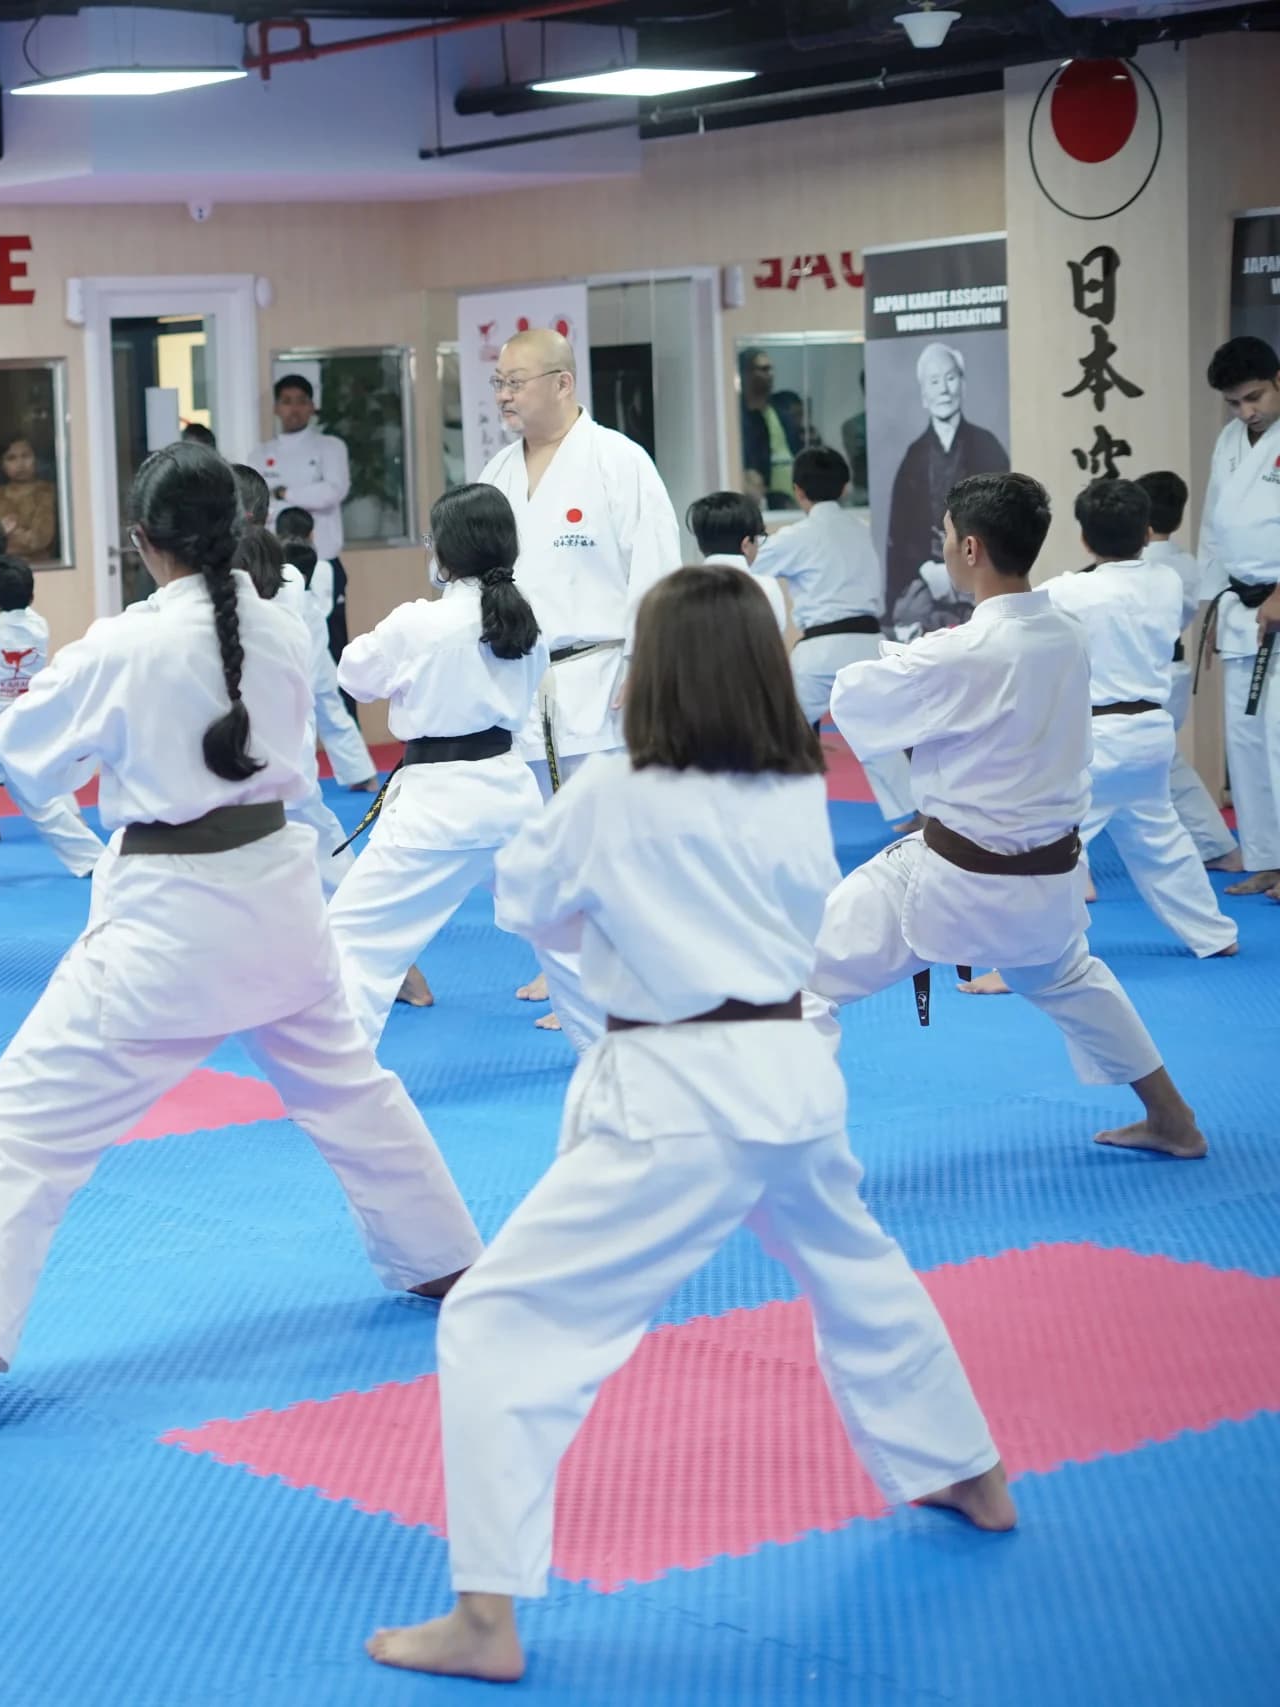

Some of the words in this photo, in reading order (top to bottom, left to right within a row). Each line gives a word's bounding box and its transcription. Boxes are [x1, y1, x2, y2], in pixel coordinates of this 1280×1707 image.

[873, 293, 907, 314] JAPAN
[907, 290, 949, 311] KARATE
[895, 312, 935, 332] WORLD
[936, 306, 1002, 329] FEDERATION
